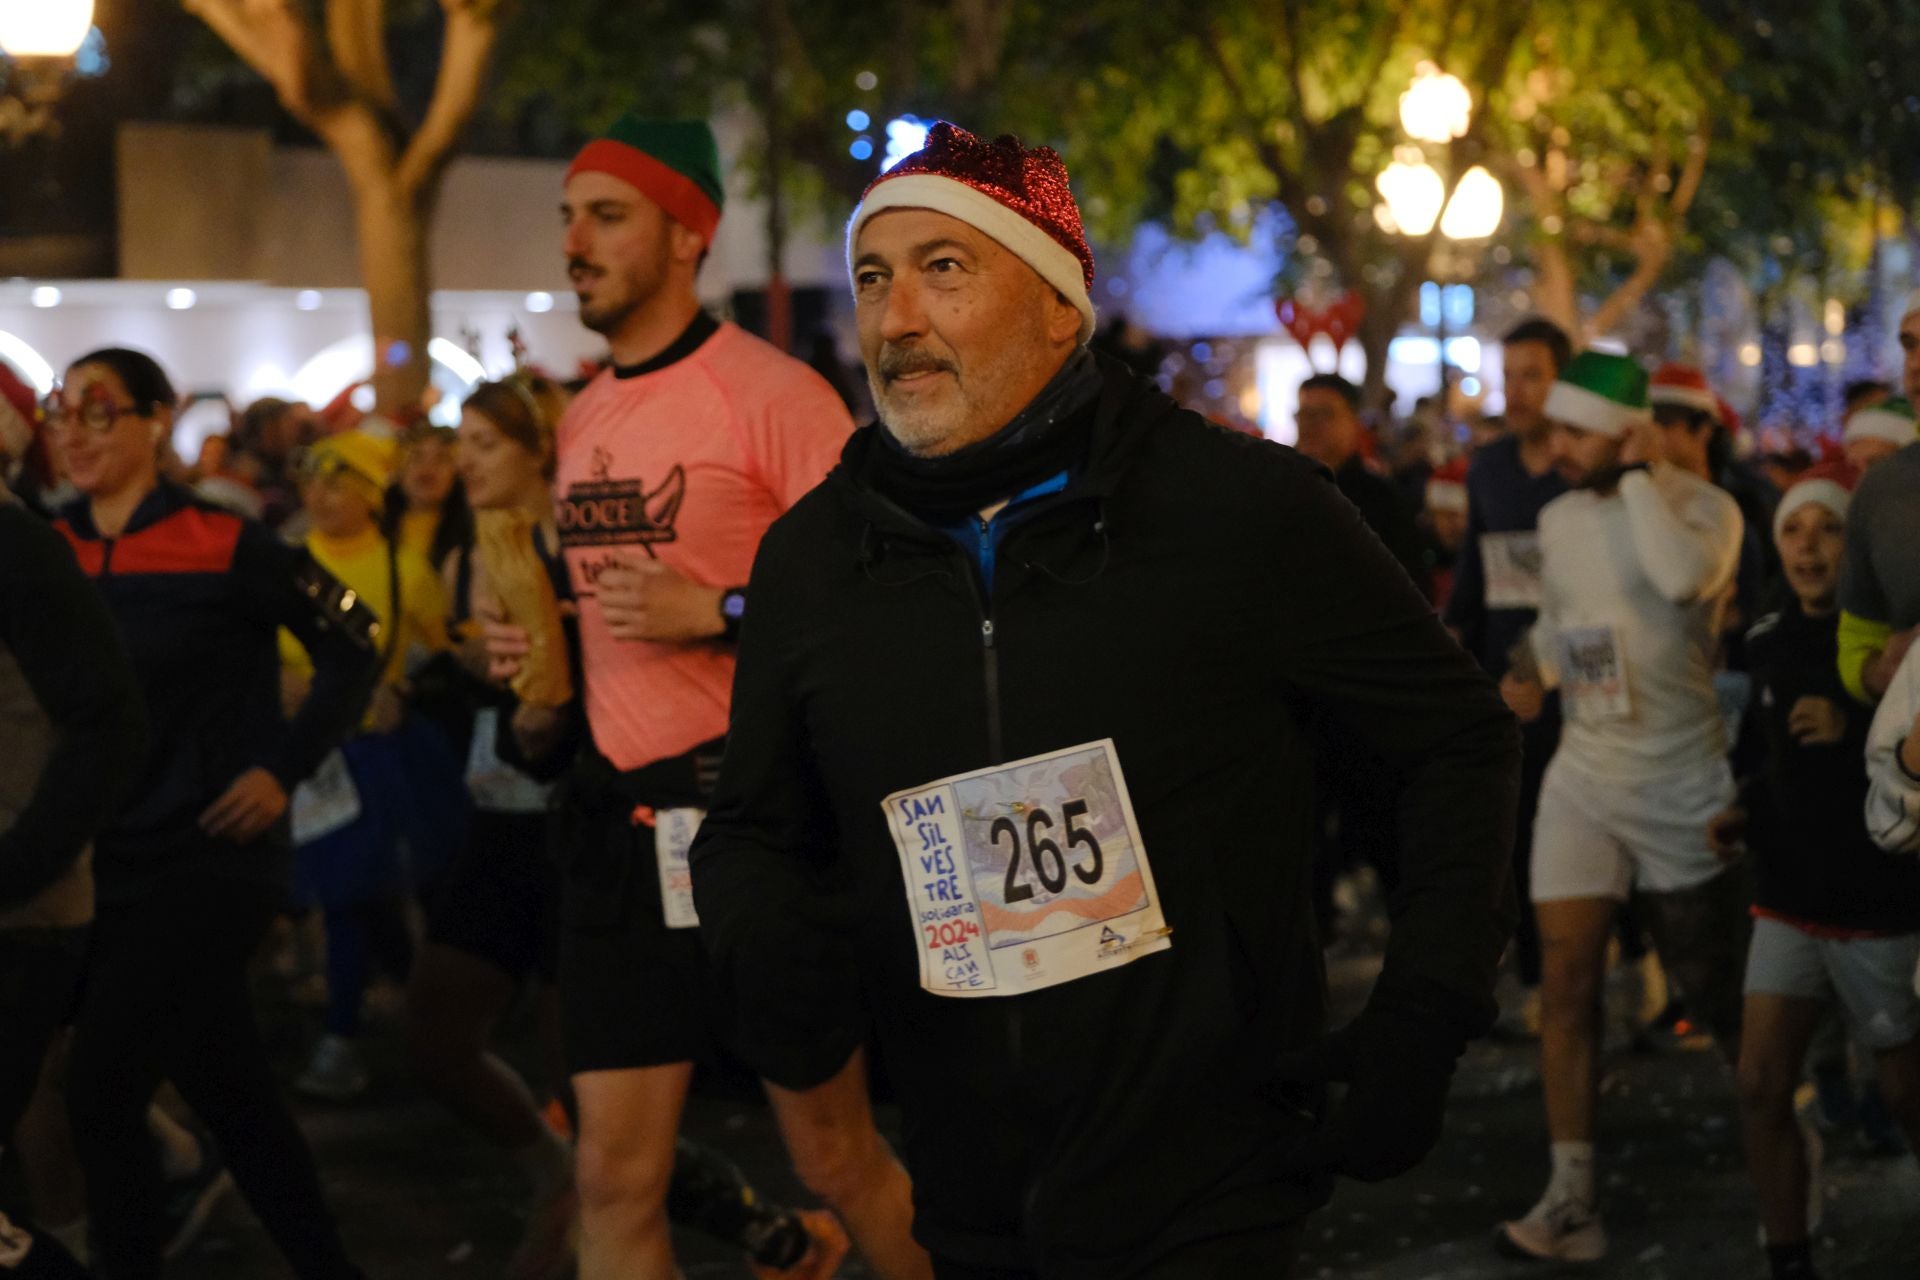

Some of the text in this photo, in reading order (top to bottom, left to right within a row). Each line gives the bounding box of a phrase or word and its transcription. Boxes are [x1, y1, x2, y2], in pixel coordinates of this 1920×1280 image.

[899, 794, 945, 826] SAN
[920, 845, 956, 875] VES
[990, 798, 1104, 905] 265
[924, 874, 963, 902] TRE
[920, 900, 976, 923] solidaria
[925, 918, 980, 949] 2024
[943, 943, 973, 965] ALI
[945, 960, 979, 980] CAN
[946, 974, 985, 989] TE
